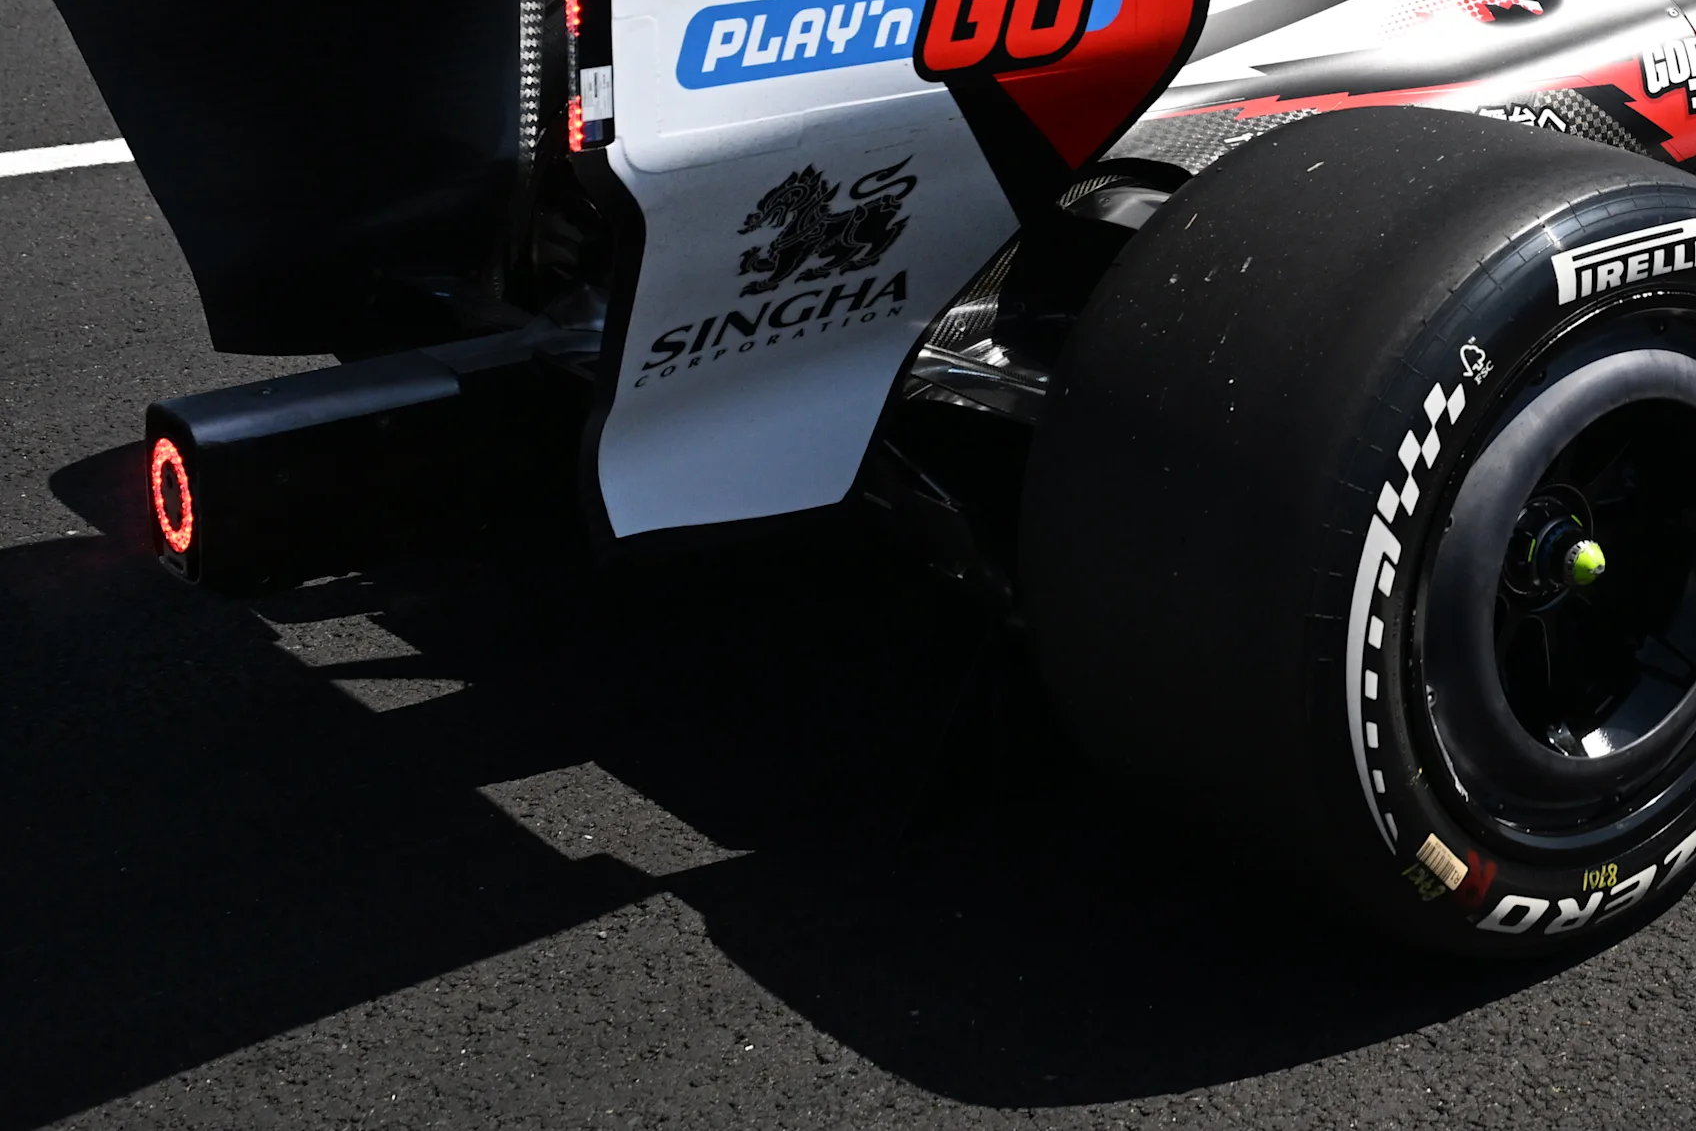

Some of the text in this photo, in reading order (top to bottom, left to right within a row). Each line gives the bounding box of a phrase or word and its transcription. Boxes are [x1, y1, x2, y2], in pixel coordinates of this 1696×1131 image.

[702, 0, 913, 73] PLAY'n
[634, 304, 905, 389] CORPORATION
[640, 268, 909, 372] SINGHA
[1474, 360, 1495, 386] FSC
